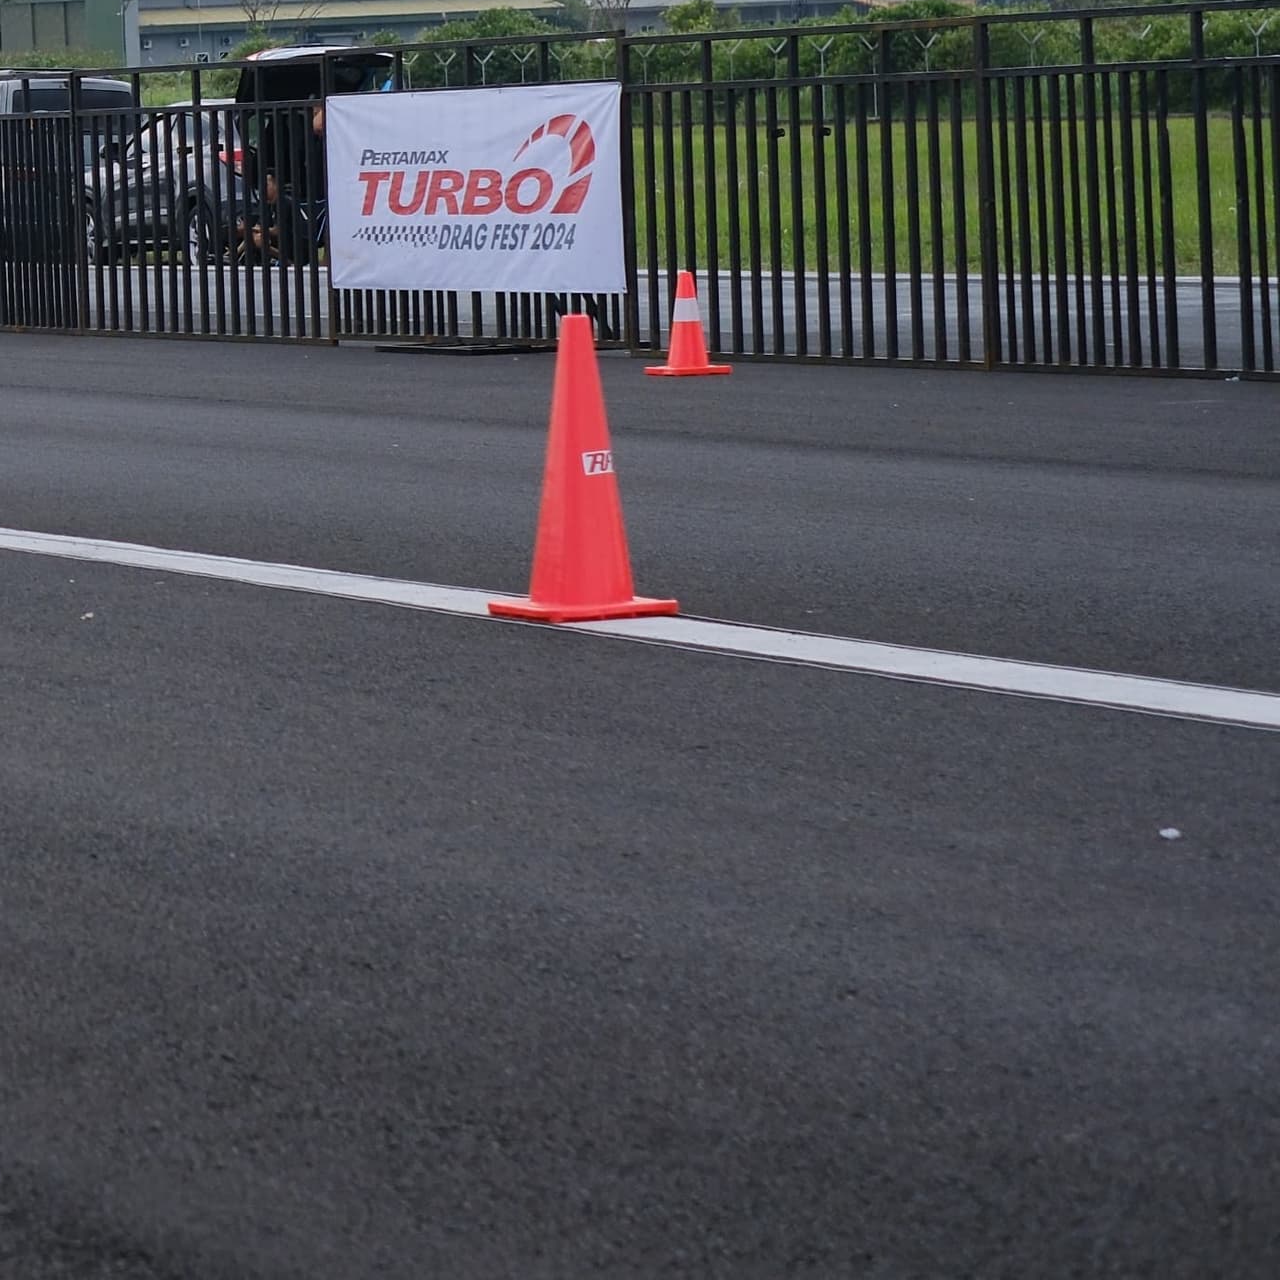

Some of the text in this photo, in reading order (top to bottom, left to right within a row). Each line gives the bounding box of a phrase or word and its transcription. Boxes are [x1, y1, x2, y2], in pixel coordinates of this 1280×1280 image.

[360, 149, 450, 167] PERTAMAX
[358, 168, 554, 217] TURBO
[438, 222, 577, 251] DRAG FEST 2024
